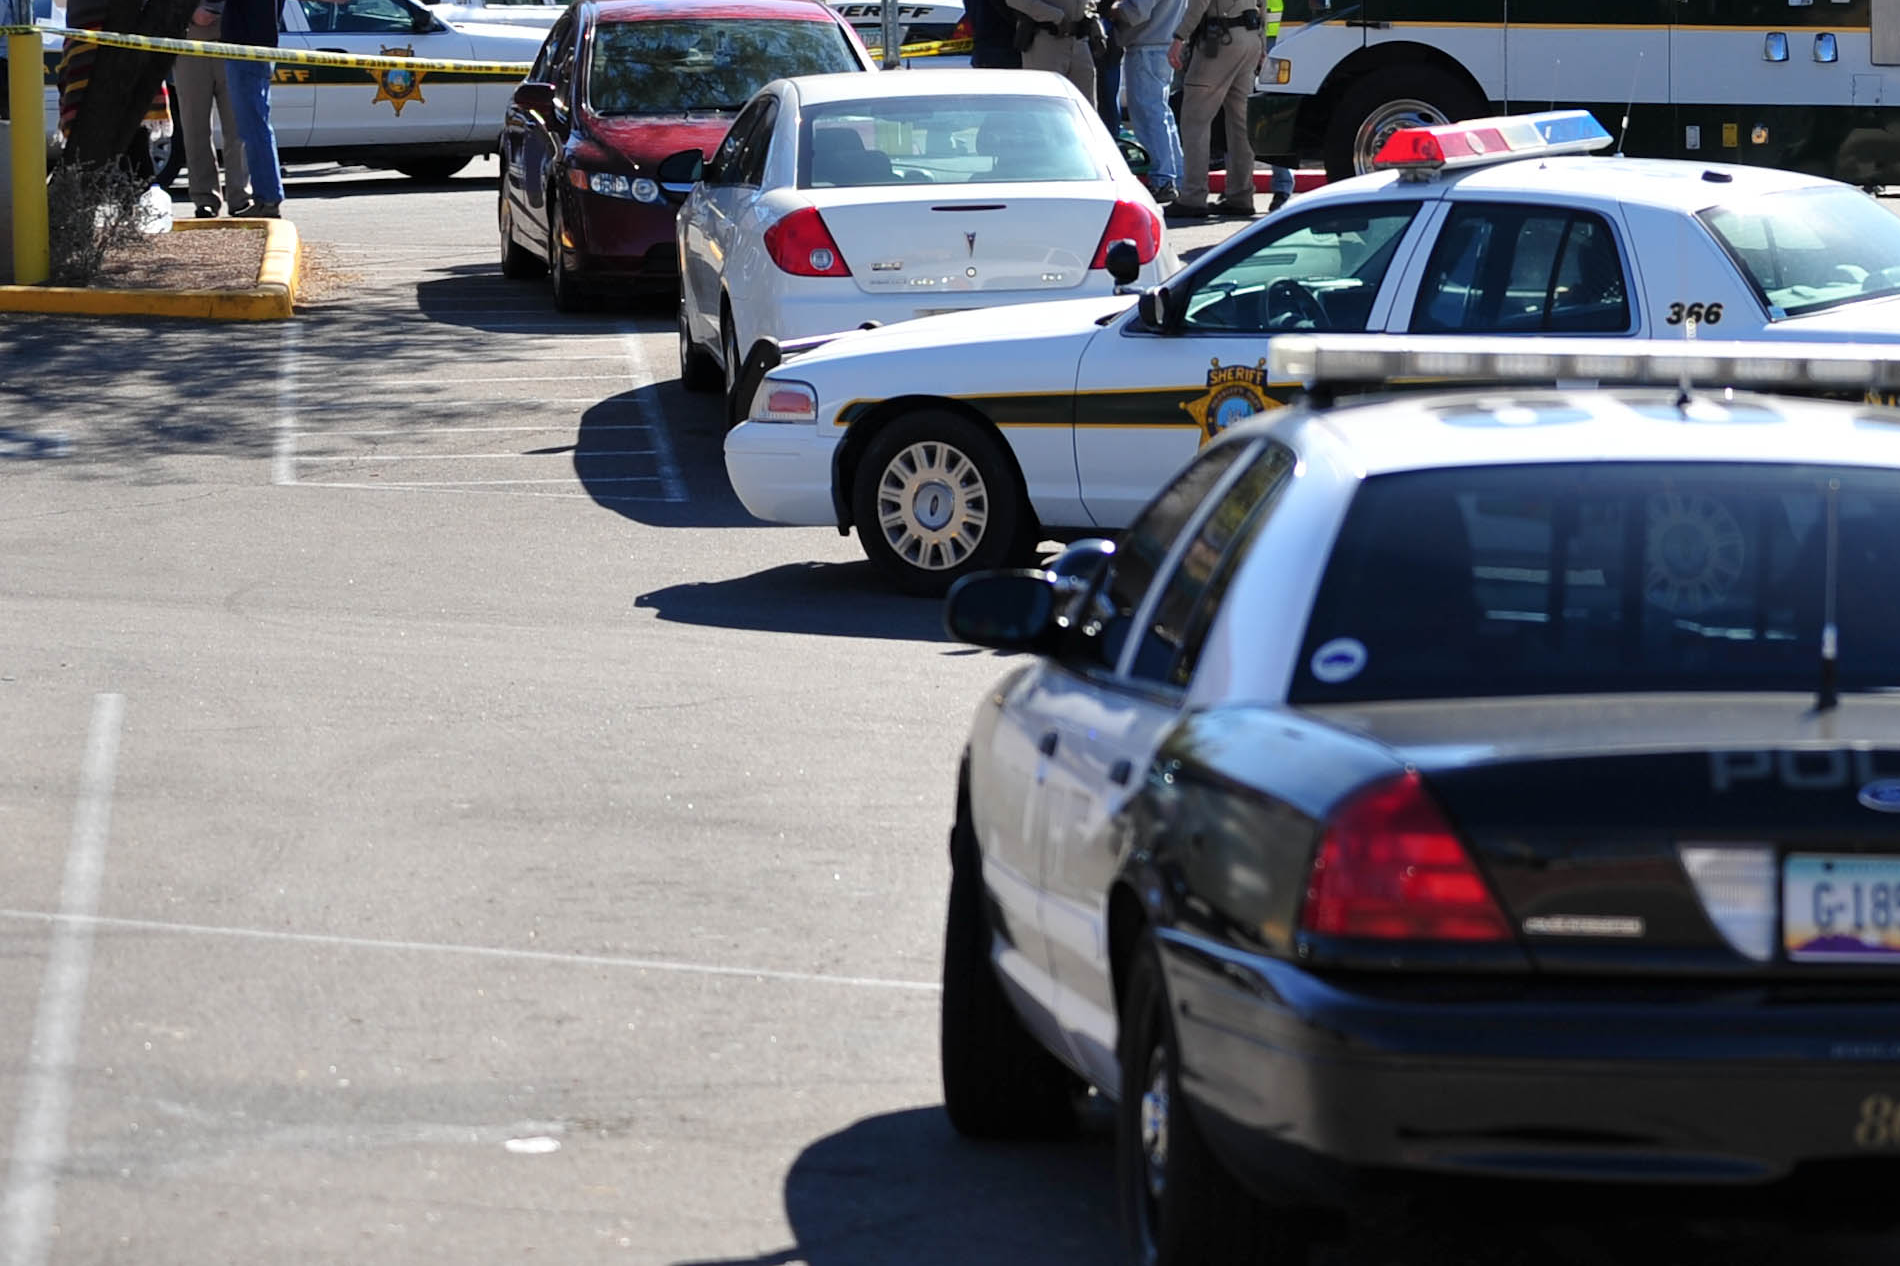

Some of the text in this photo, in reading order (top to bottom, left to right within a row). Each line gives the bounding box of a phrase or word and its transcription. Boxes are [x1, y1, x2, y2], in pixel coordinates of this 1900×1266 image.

[837, 5, 934, 18] ERFF
[1665, 301, 1724, 326] 366
[1209, 366, 1264, 386] SHERIFF
